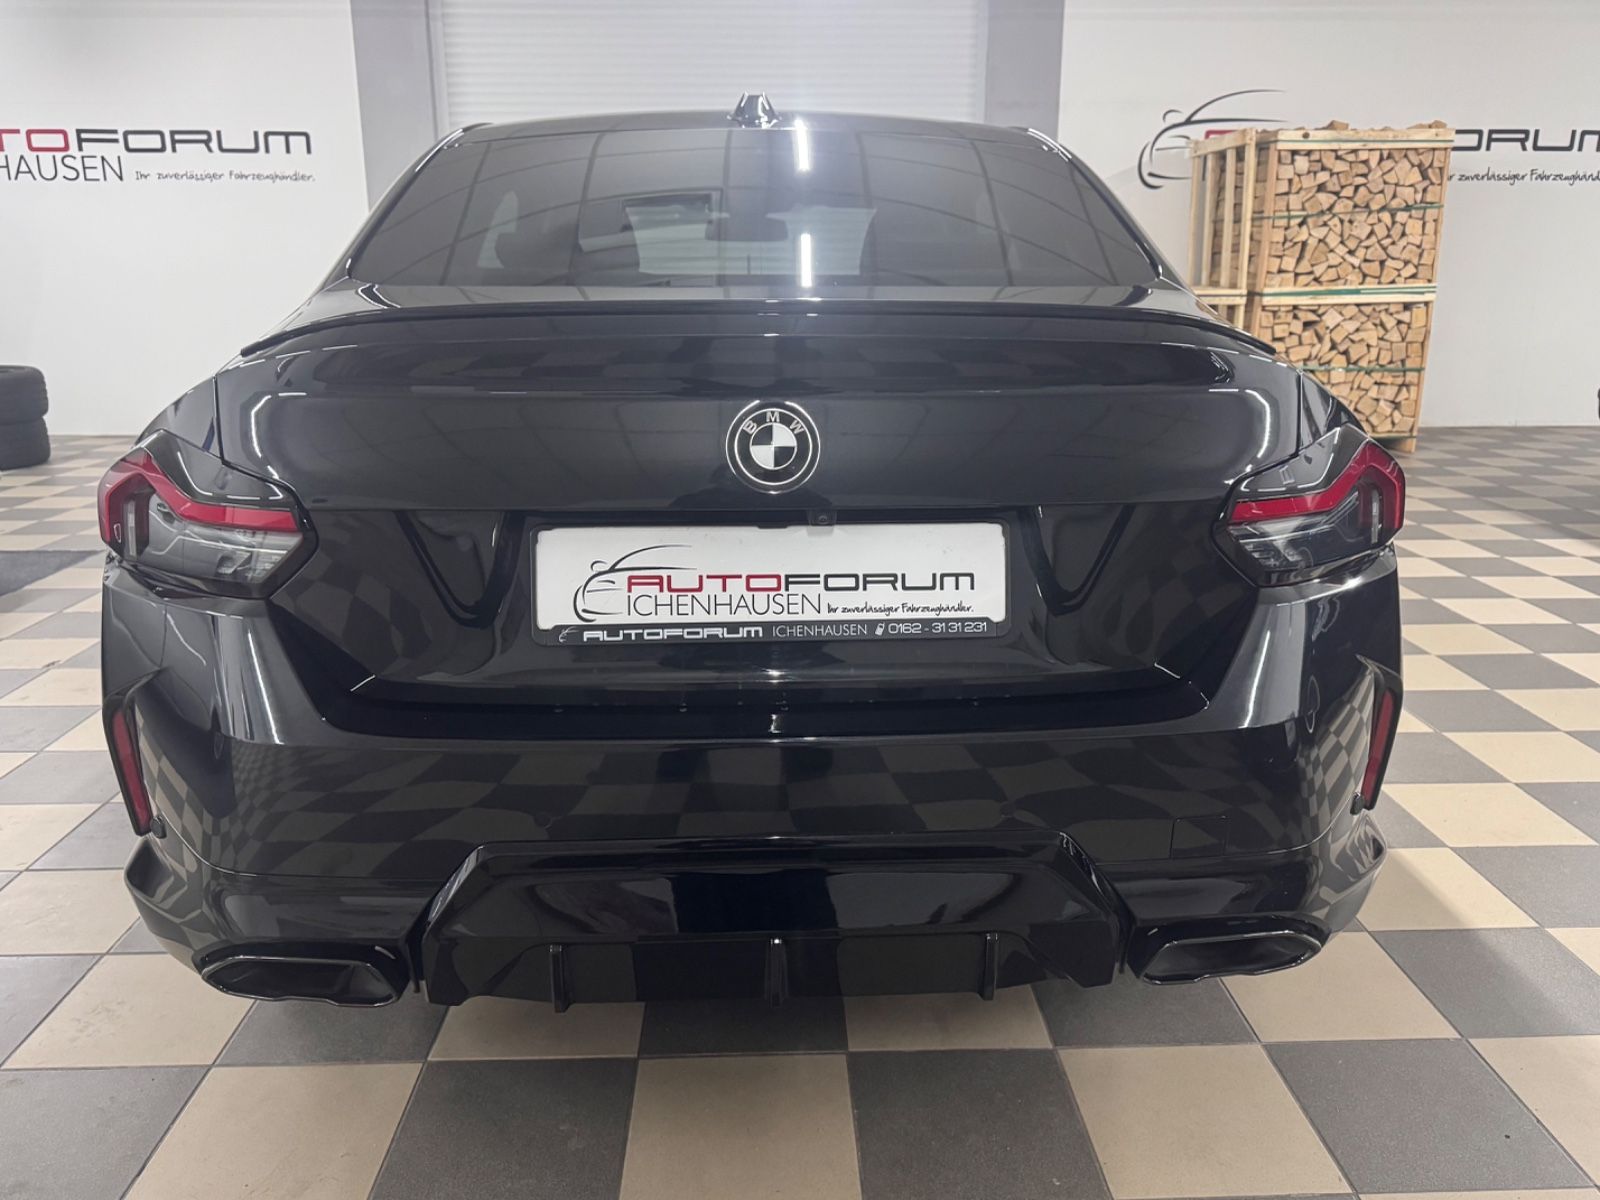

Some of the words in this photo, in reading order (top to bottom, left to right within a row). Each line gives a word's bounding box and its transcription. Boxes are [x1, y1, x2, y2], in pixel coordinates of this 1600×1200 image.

[135, 170, 150, 180] Ihr
[1458, 166, 1527, 186] zuverlässiger
[742, 410, 804, 435] BMW
[627, 572, 975, 593] AUTOFORUM
[627, 593, 821, 616] ICHENHAUSEN
[827, 602, 839, 614] Ihr
[583, 626, 763, 642] AUTOFORUM
[772, 623, 867, 638] ICHENHAUSEN
[888, 622, 922, 634] 0162
